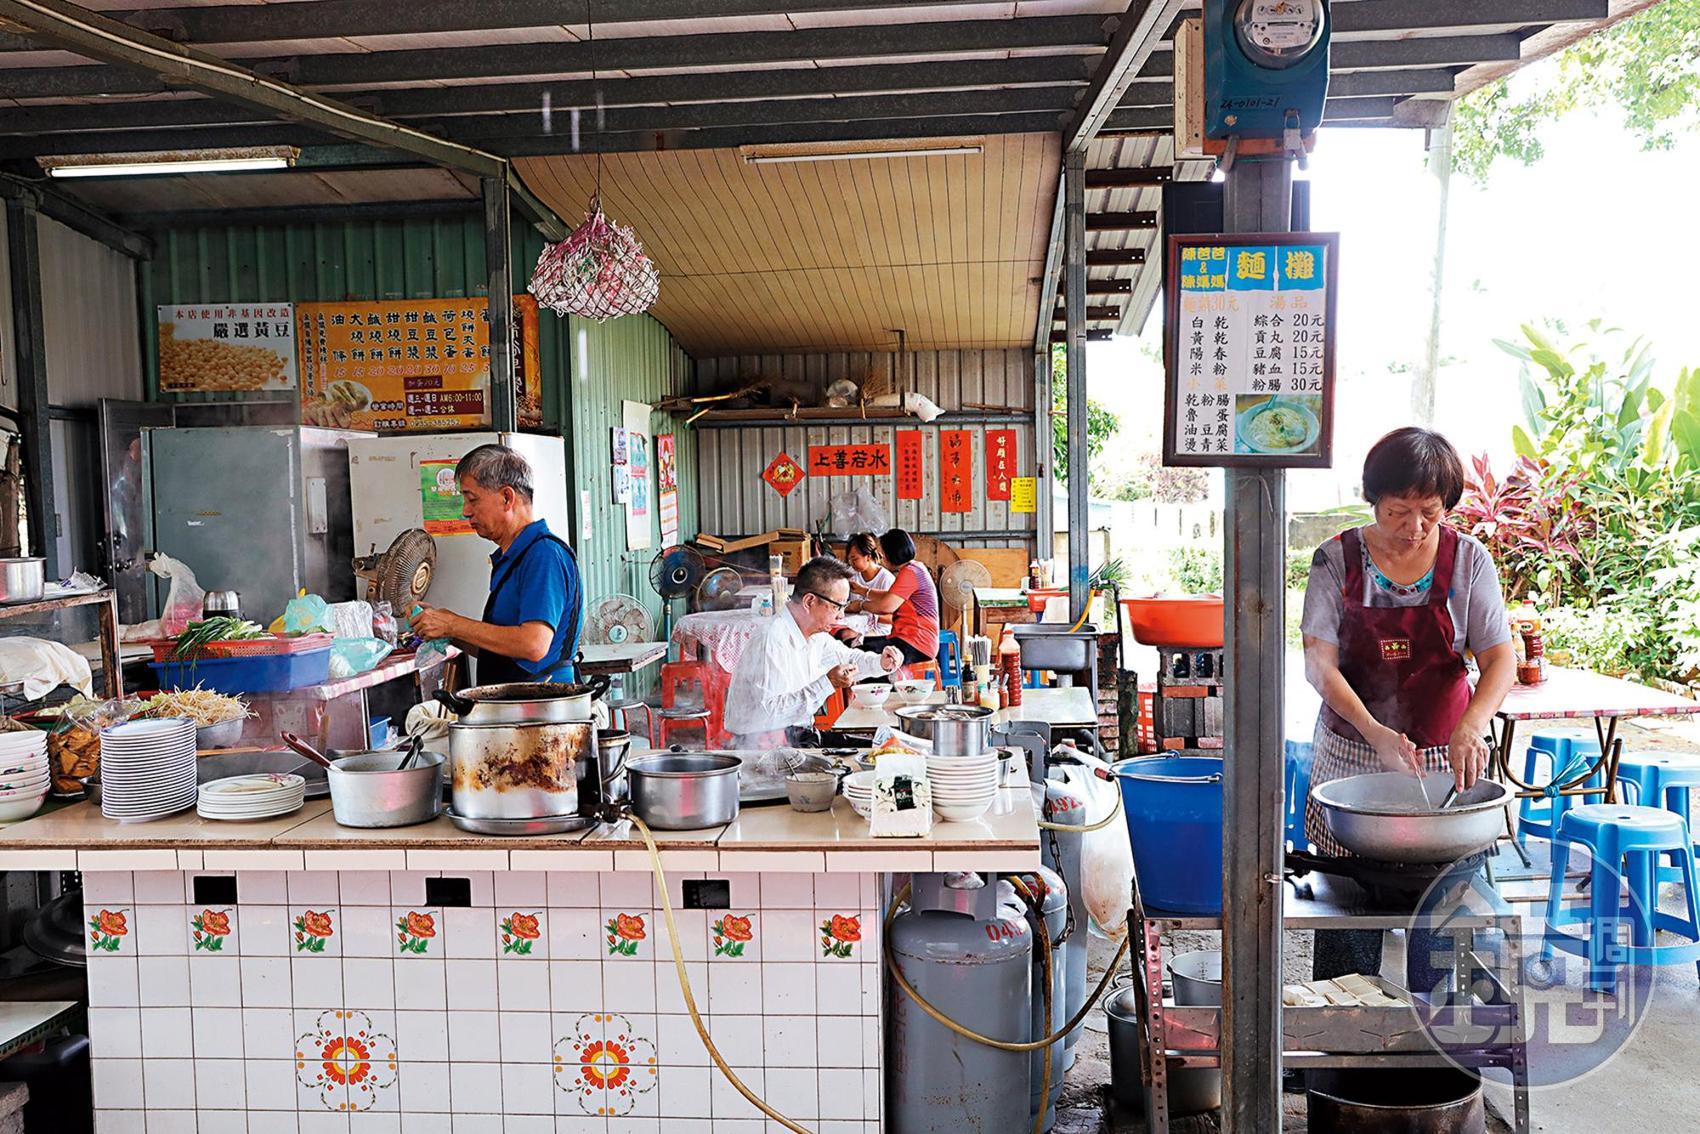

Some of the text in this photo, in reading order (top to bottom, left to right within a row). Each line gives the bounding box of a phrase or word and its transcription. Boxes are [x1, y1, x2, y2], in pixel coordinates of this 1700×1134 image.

[1181, 246, 1315, 280] 陳爸爸 麵攤
[1199, 261, 1208, 274] &
[1181, 274, 1226, 289] 陳媽媽
[1269, 294, 1309, 311] 湯品
[175, 307, 291, 320] 本店使用非基因改造
[1253, 312, 1285, 328] 綜合
[212, 321, 291, 339] 嚴選黃豆
[349, 313, 366, 362] 大燒餅
[367, 312, 384, 361] 鹹燒餅
[386, 312, 403, 360] 甜燒餅
[404, 311, 420, 360] 甜豆漿
[423, 310, 439, 360] 鹹豆漿
[1253, 330, 1285, 345] 貢丸
[1253, 346, 1282, 361] 豆腐
[1252, 362, 1283, 376] 豬血
[1251, 378, 1282, 392] 粉腸
[1185, 393, 1231, 408] 乾粉腸
[440, 404, 456, 414] 公休
[1184, 423, 1229, 438] 油豆腐
[1184, 438, 1228, 453] 燙青菜
[814, 449, 889, 470] 上善若水
